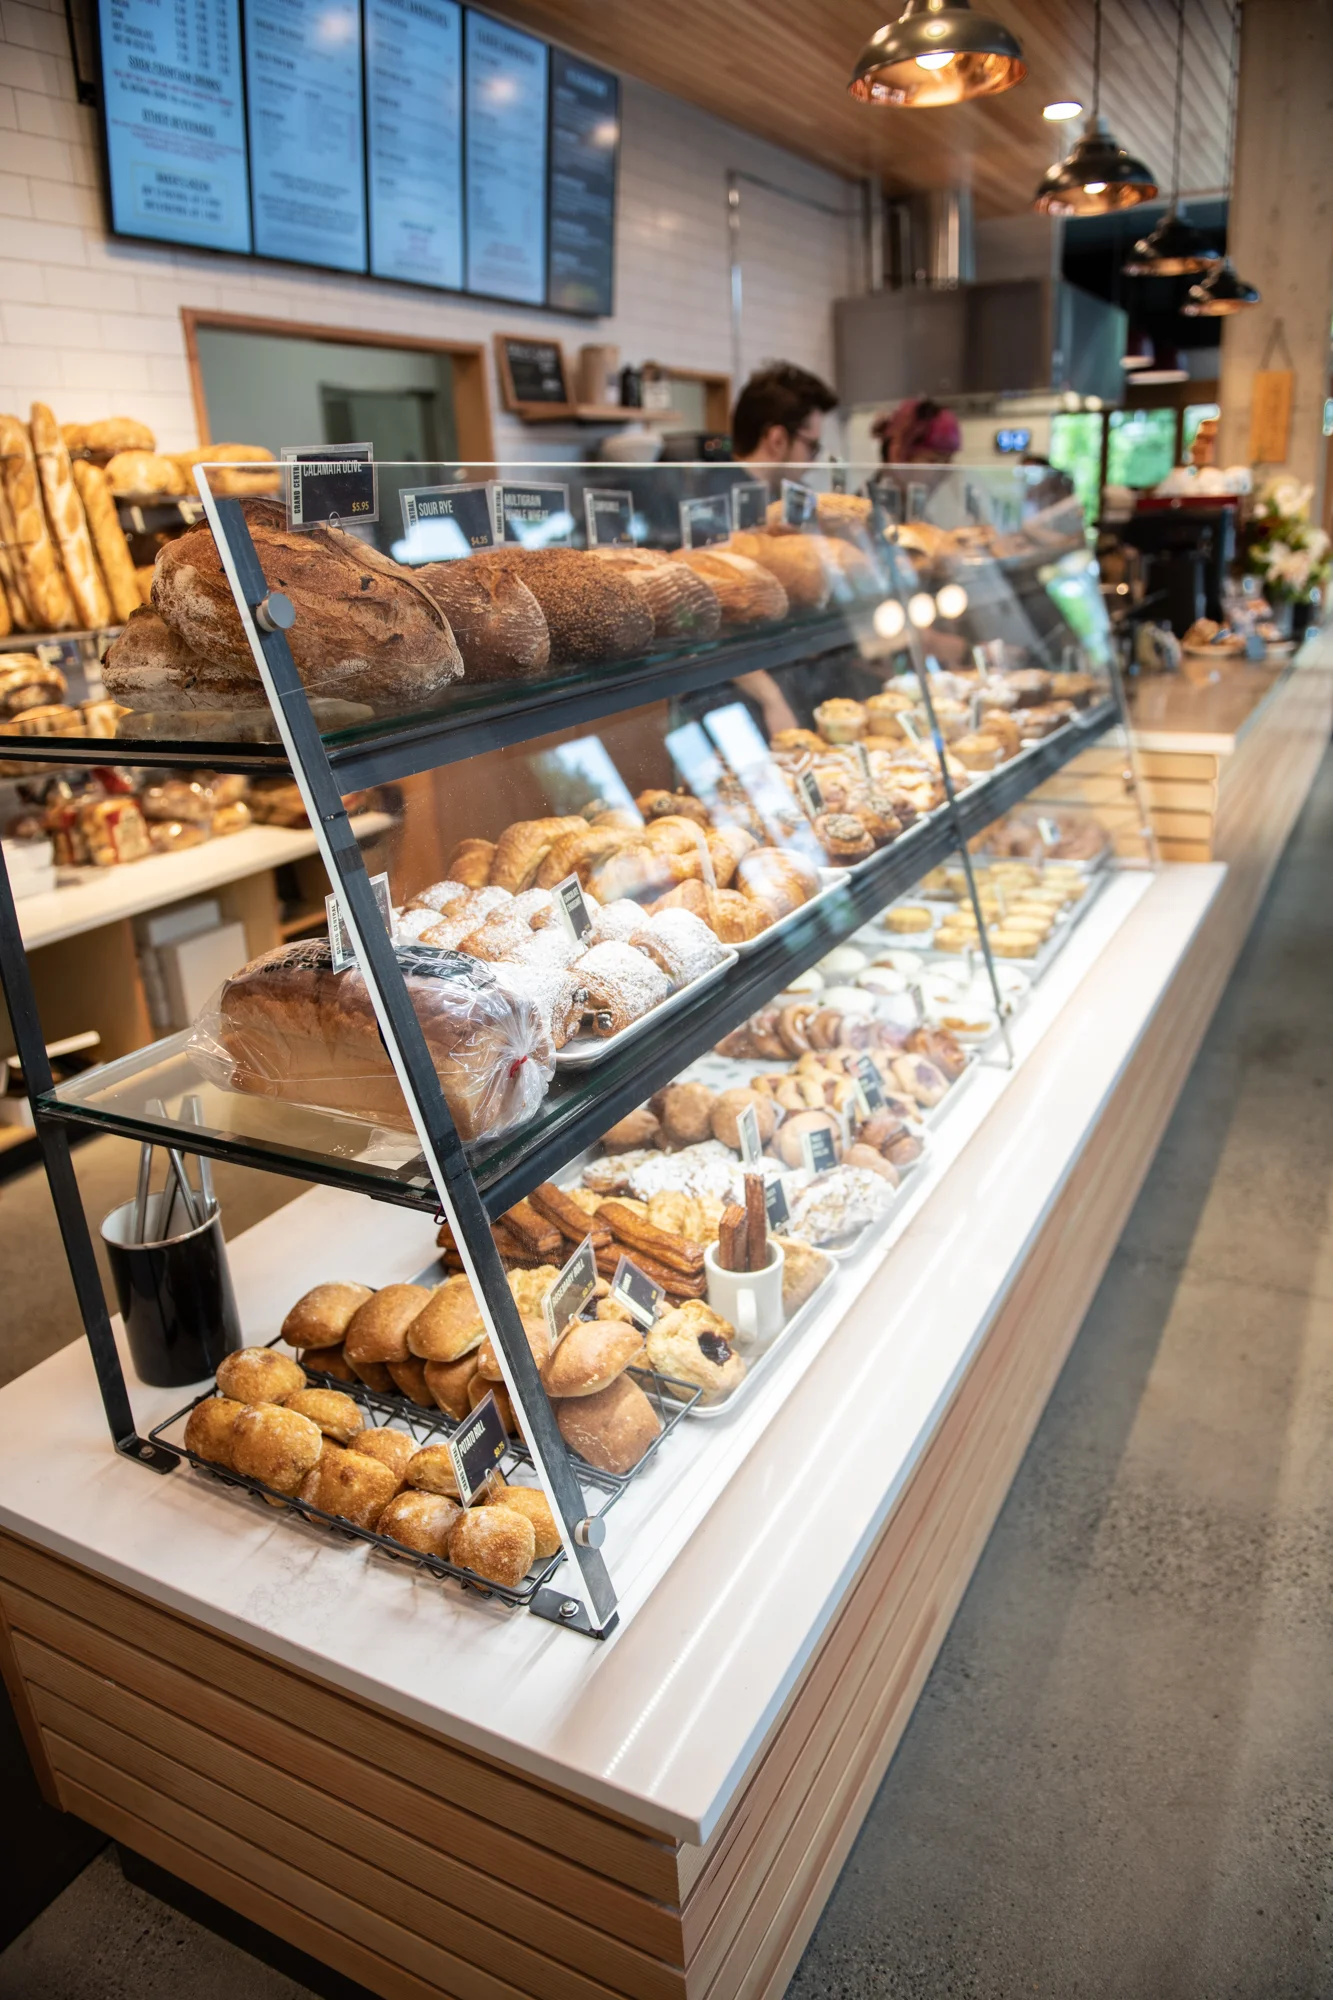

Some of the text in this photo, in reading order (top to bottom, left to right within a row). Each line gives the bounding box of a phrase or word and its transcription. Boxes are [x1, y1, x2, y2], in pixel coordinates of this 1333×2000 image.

[303, 459, 362, 477] CALAMATA OLIVE
[292, 459, 301, 514] GRAND CENTR
[352, 501, 370, 512] $5.95
[418, 499, 454, 517] SOUR RYE
[458, 1420, 486, 1458] POTATO ROLL
